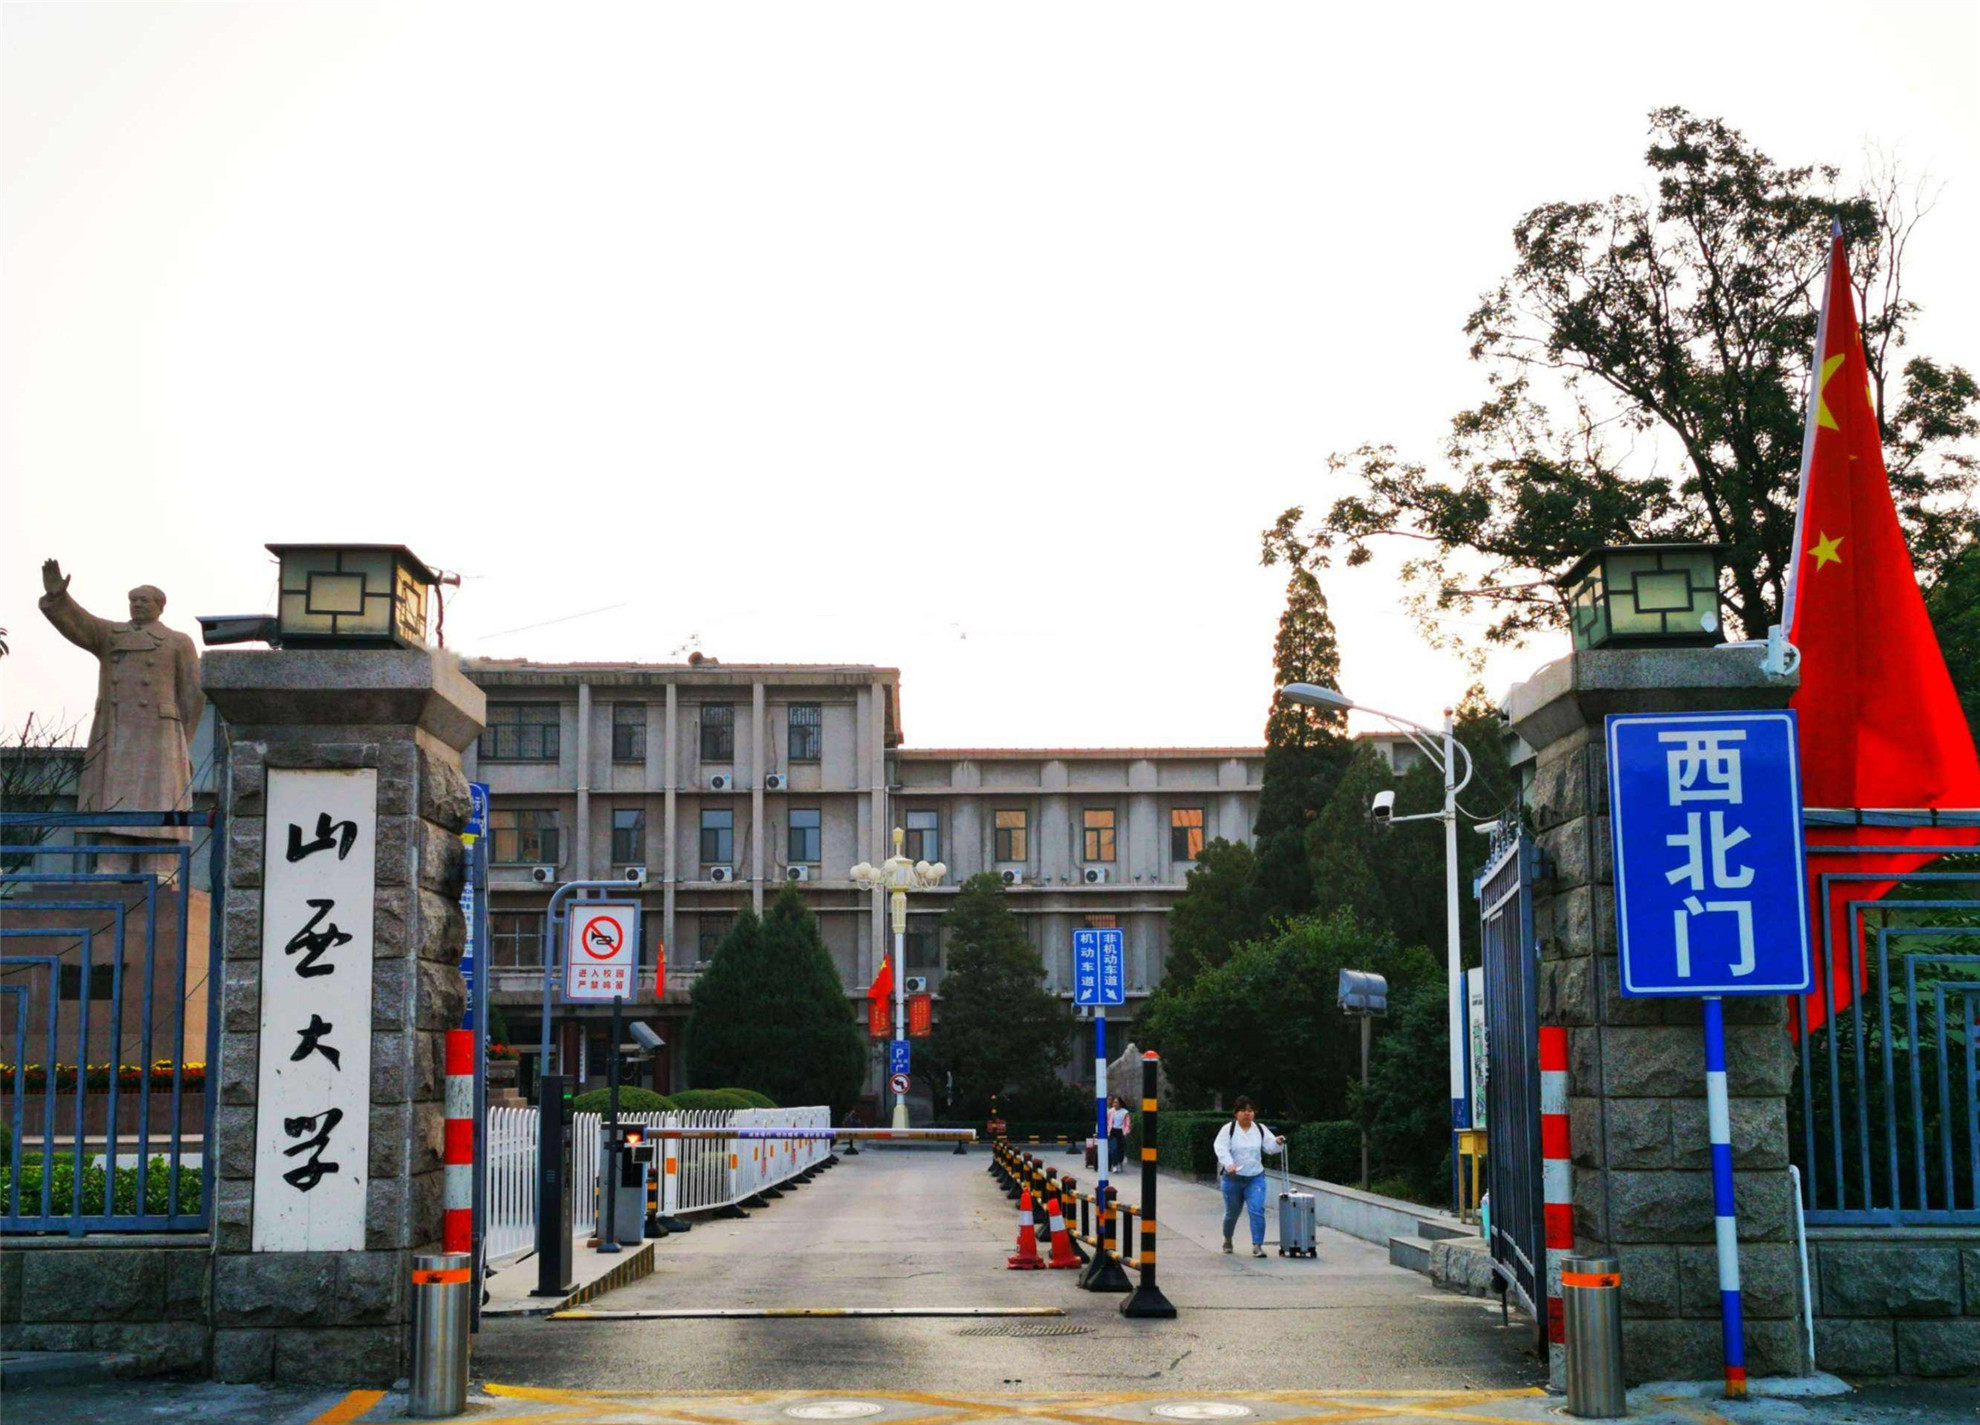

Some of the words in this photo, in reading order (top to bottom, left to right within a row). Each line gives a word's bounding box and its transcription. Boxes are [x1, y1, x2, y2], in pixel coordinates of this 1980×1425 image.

[1658, 730, 1756, 978] 西北门
[578, 968, 625, 978] 进入校园
[1080, 933, 1095, 987] 机动车道
[1103, 933, 1118, 986] 非机动车道
[284, 811, 359, 1193] 山西大学
